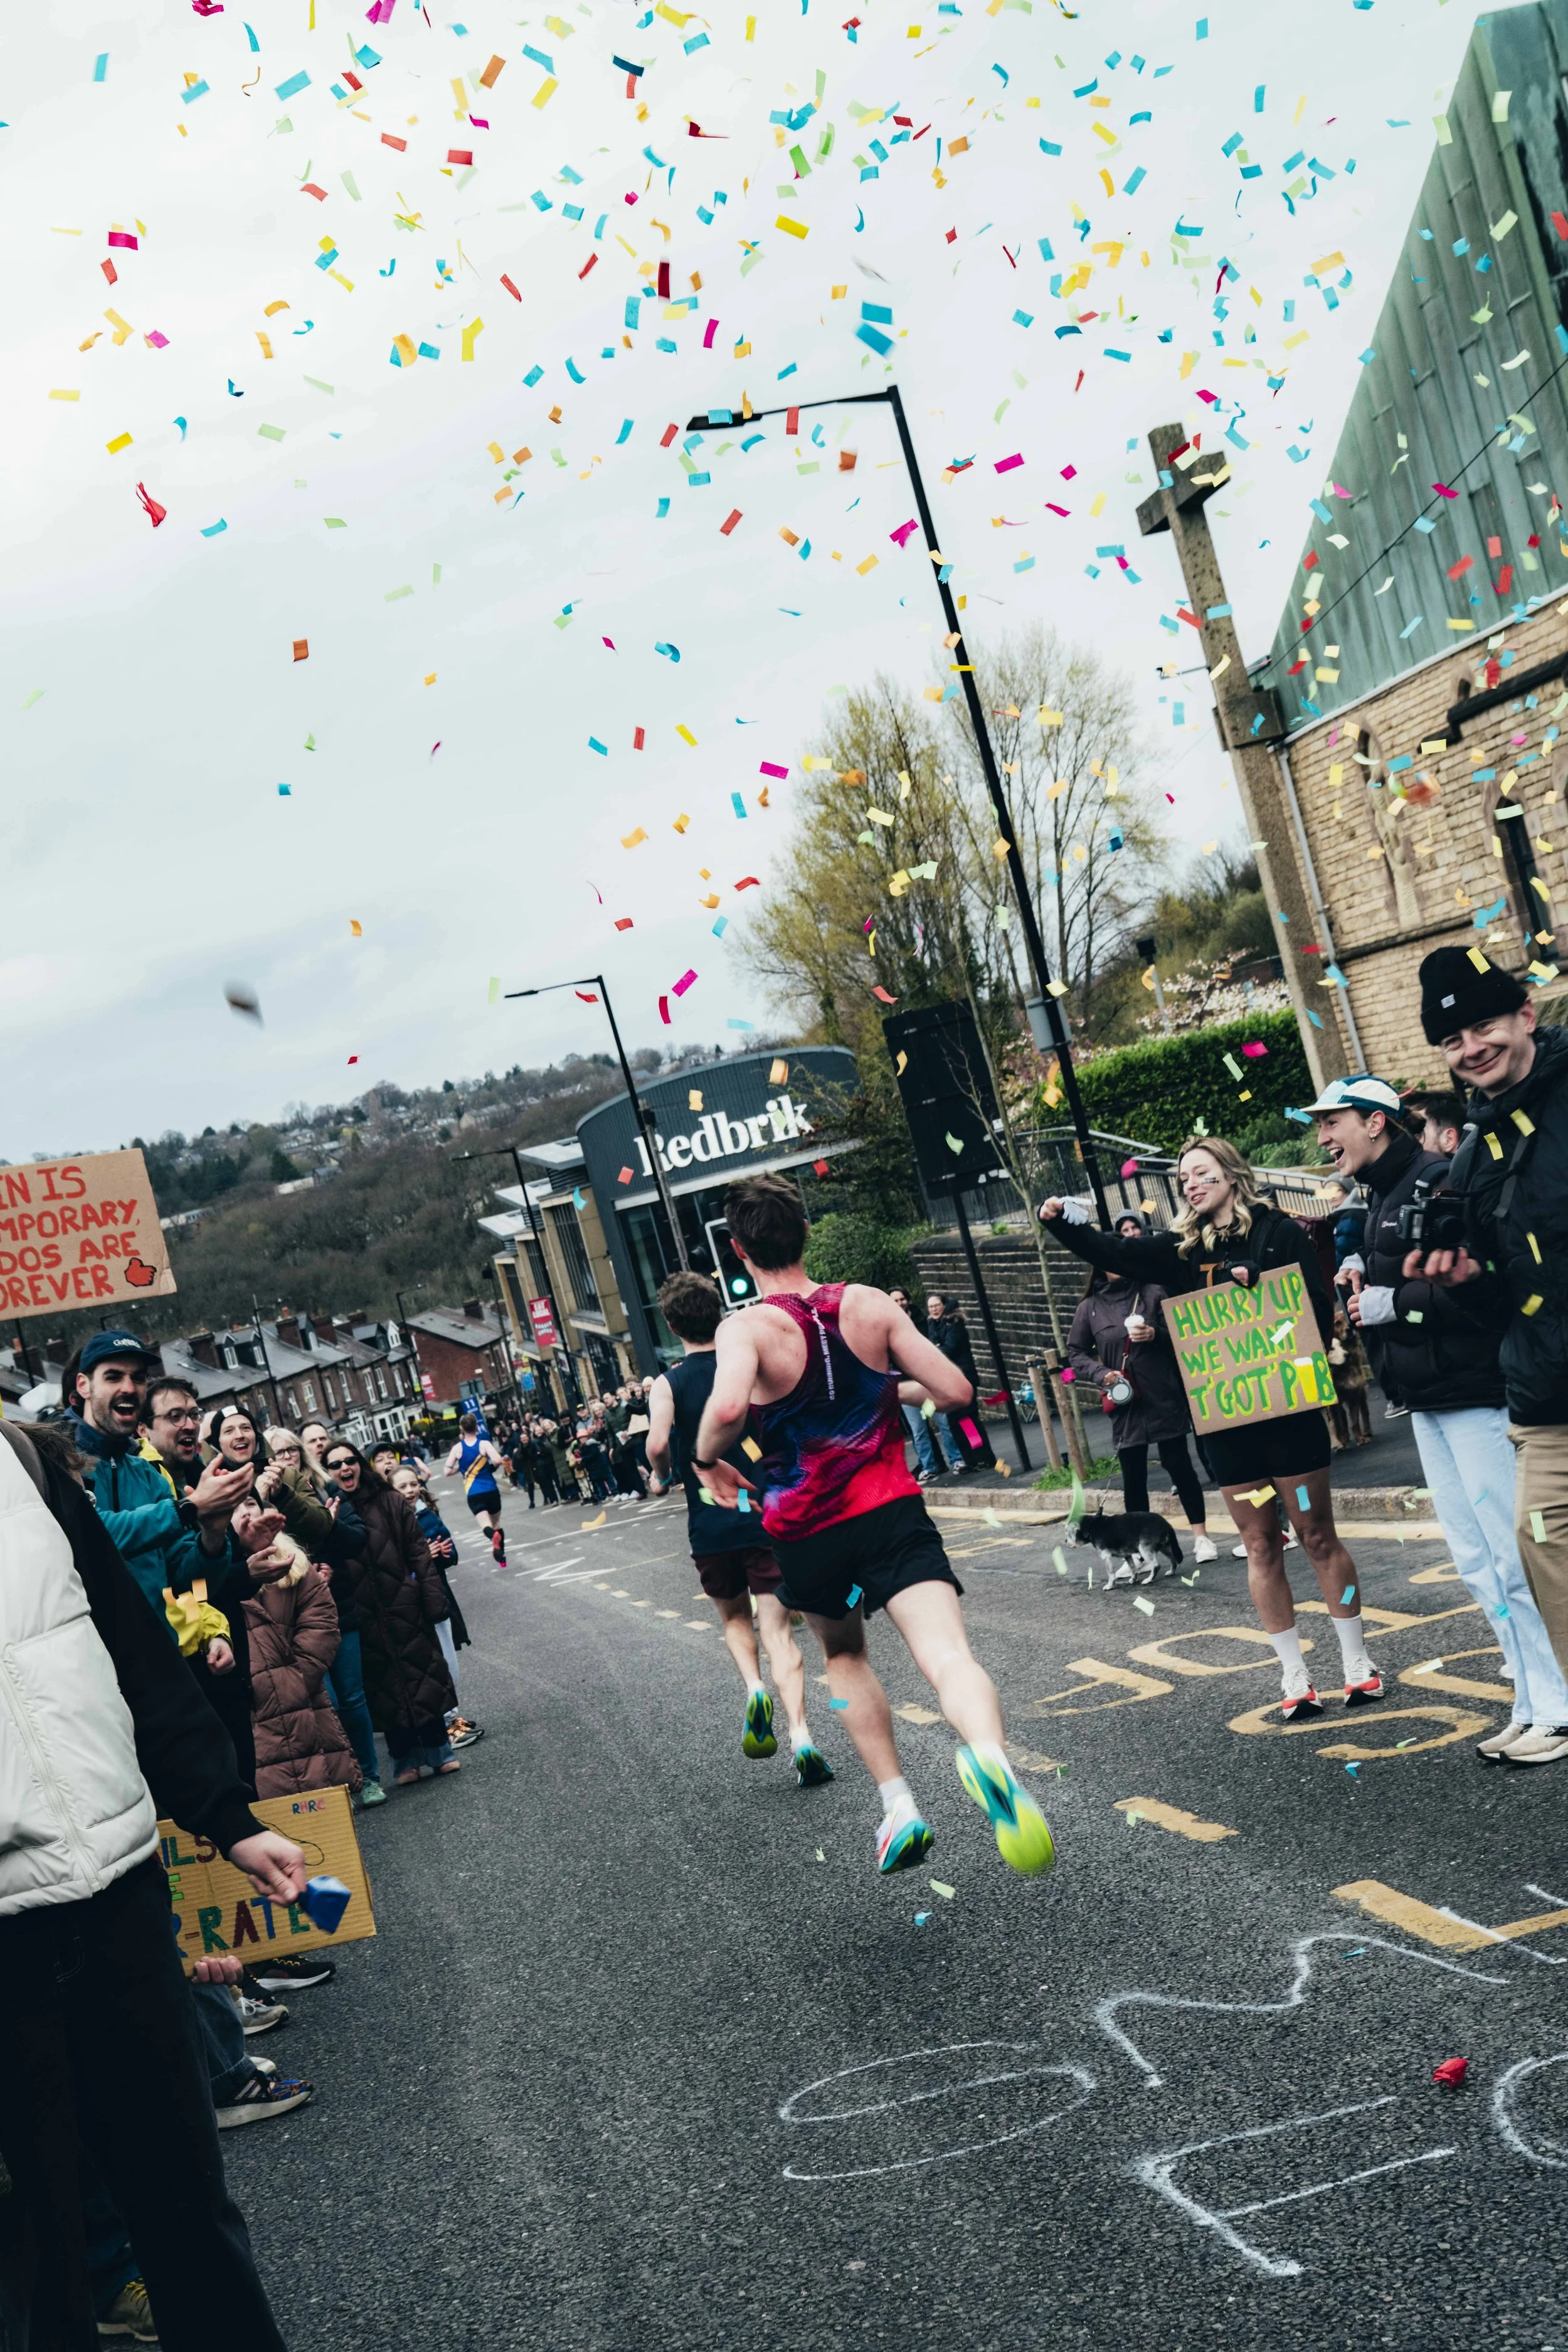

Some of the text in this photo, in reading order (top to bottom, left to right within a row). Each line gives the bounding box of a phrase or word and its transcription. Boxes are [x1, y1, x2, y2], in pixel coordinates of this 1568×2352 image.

[36, 1166, 87, 1201] IS
[79, 1231, 141, 1263] ARE
[1172, 1281, 1264, 1340] HURRY
[1268, 1271, 1303, 1315] UP
[1181, 1316, 1298, 1377] WE WANT
[292, 1798, 327, 1815] RHRC
